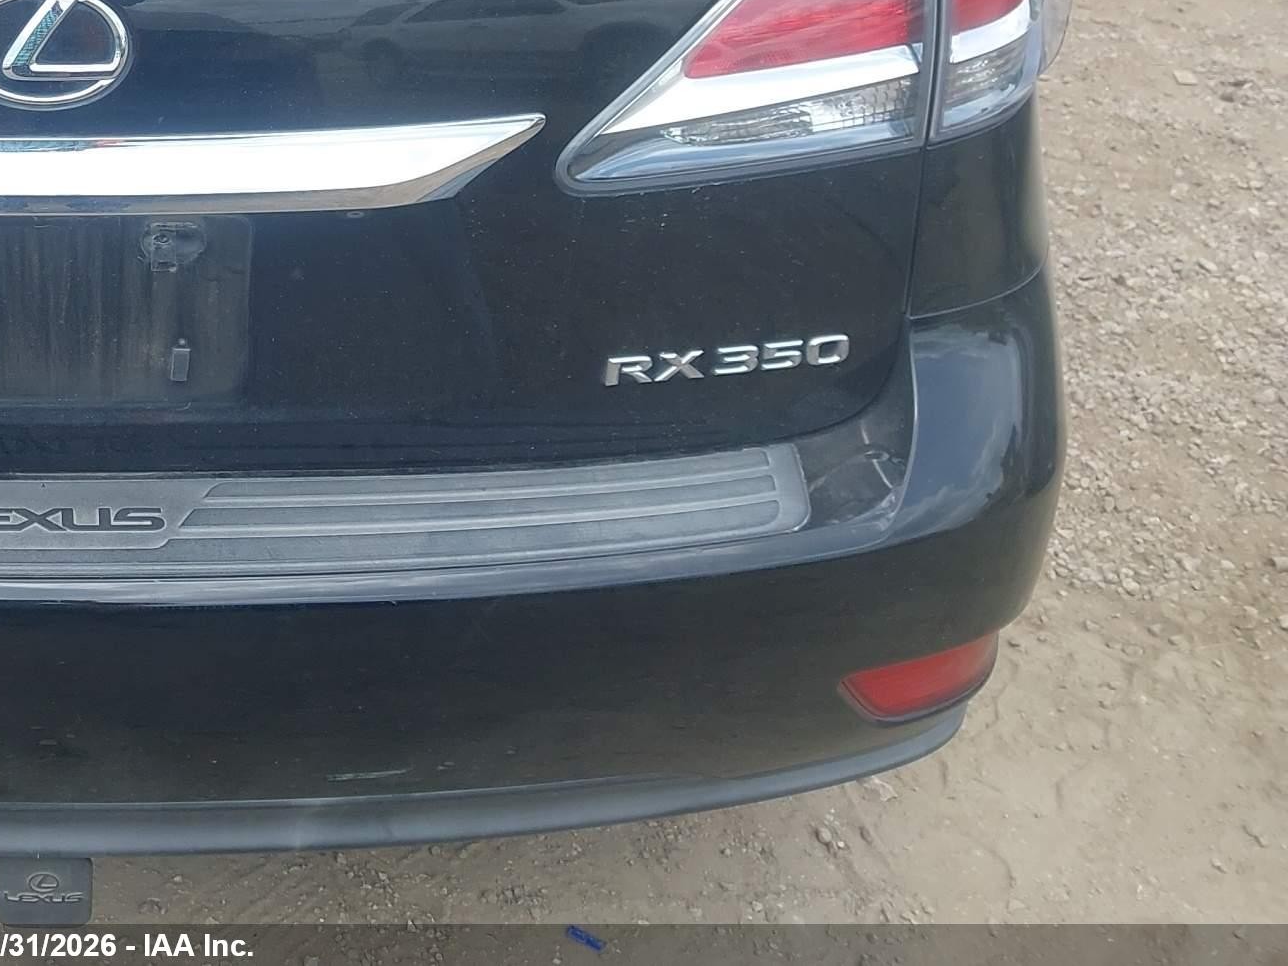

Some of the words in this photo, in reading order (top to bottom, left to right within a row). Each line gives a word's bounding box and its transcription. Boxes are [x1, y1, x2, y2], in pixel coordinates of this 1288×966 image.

[605, 349, 705, 387] RX
[713, 334, 850, 376] 350
[3, 890, 84, 904] LEXUS
